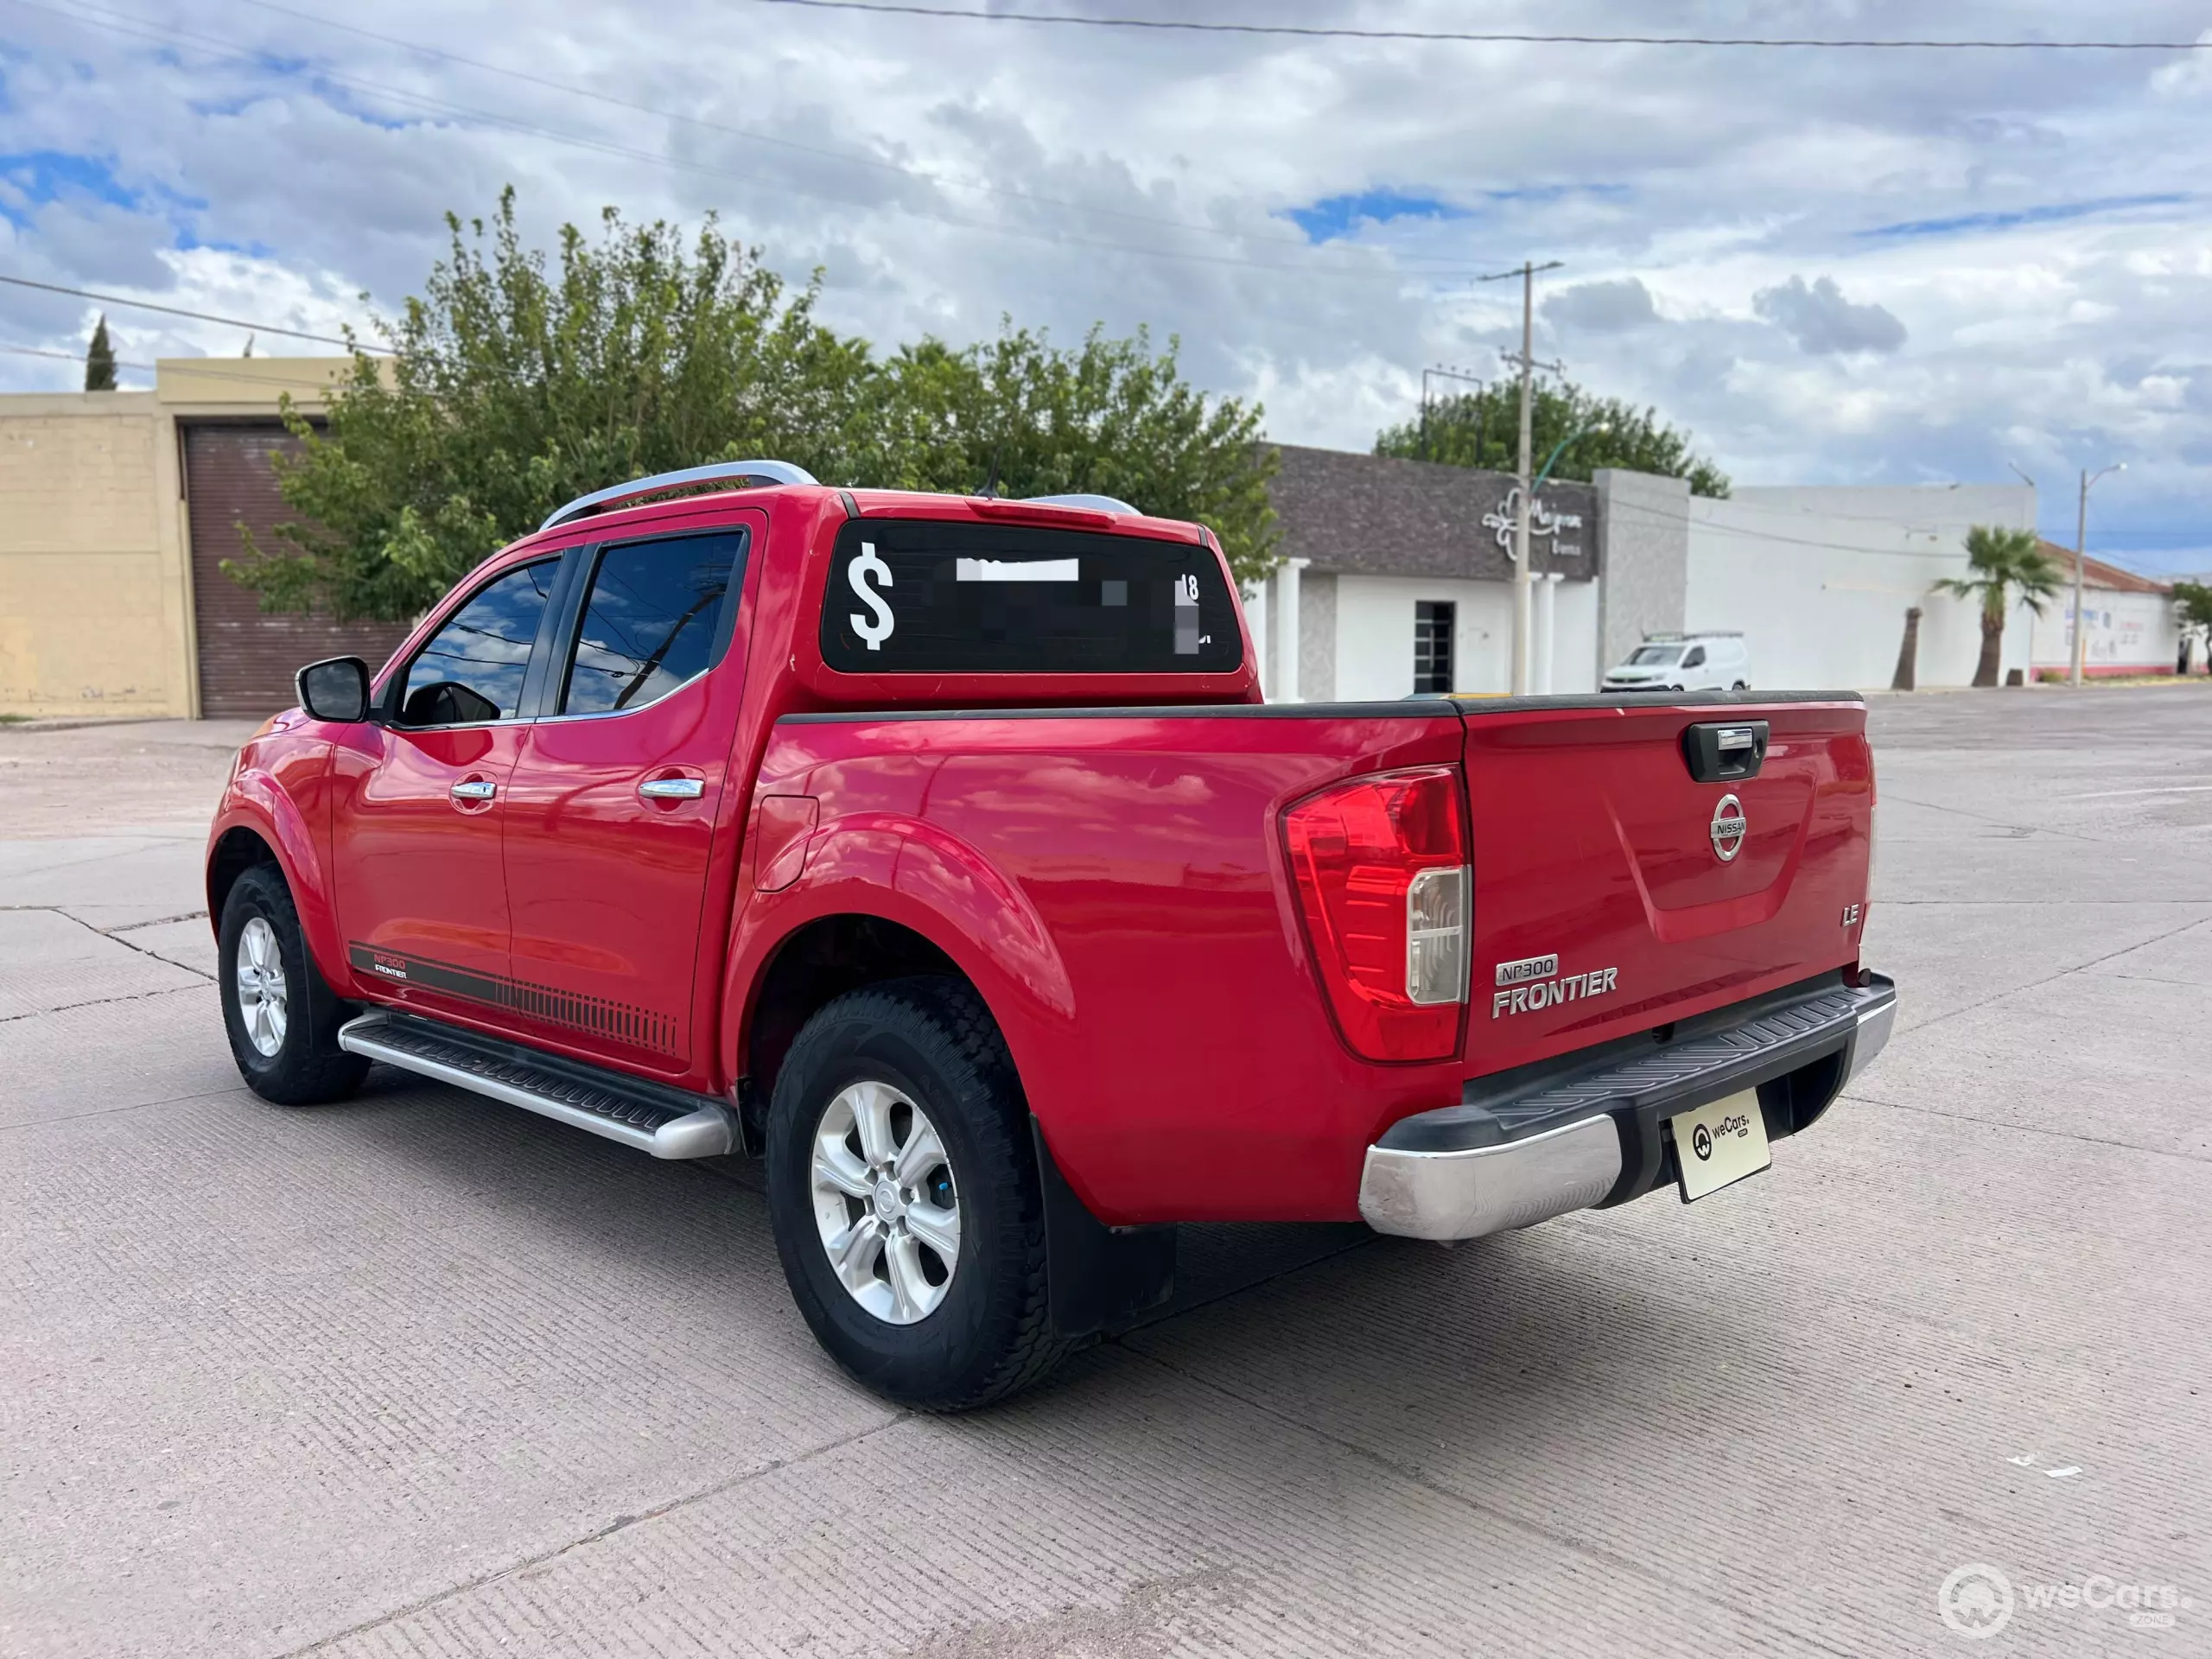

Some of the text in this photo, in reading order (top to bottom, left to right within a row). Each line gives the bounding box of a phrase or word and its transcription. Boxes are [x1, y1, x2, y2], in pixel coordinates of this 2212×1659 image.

[1717, 822, 1745, 835] NISSAN
[1842, 904, 1859, 926] LE
[373, 953, 406, 969] NP300
[1502, 959, 1554, 982] NP300
[375, 963, 407, 979] FRONTIER
[1492, 967, 1618, 1019] FRONTIER
